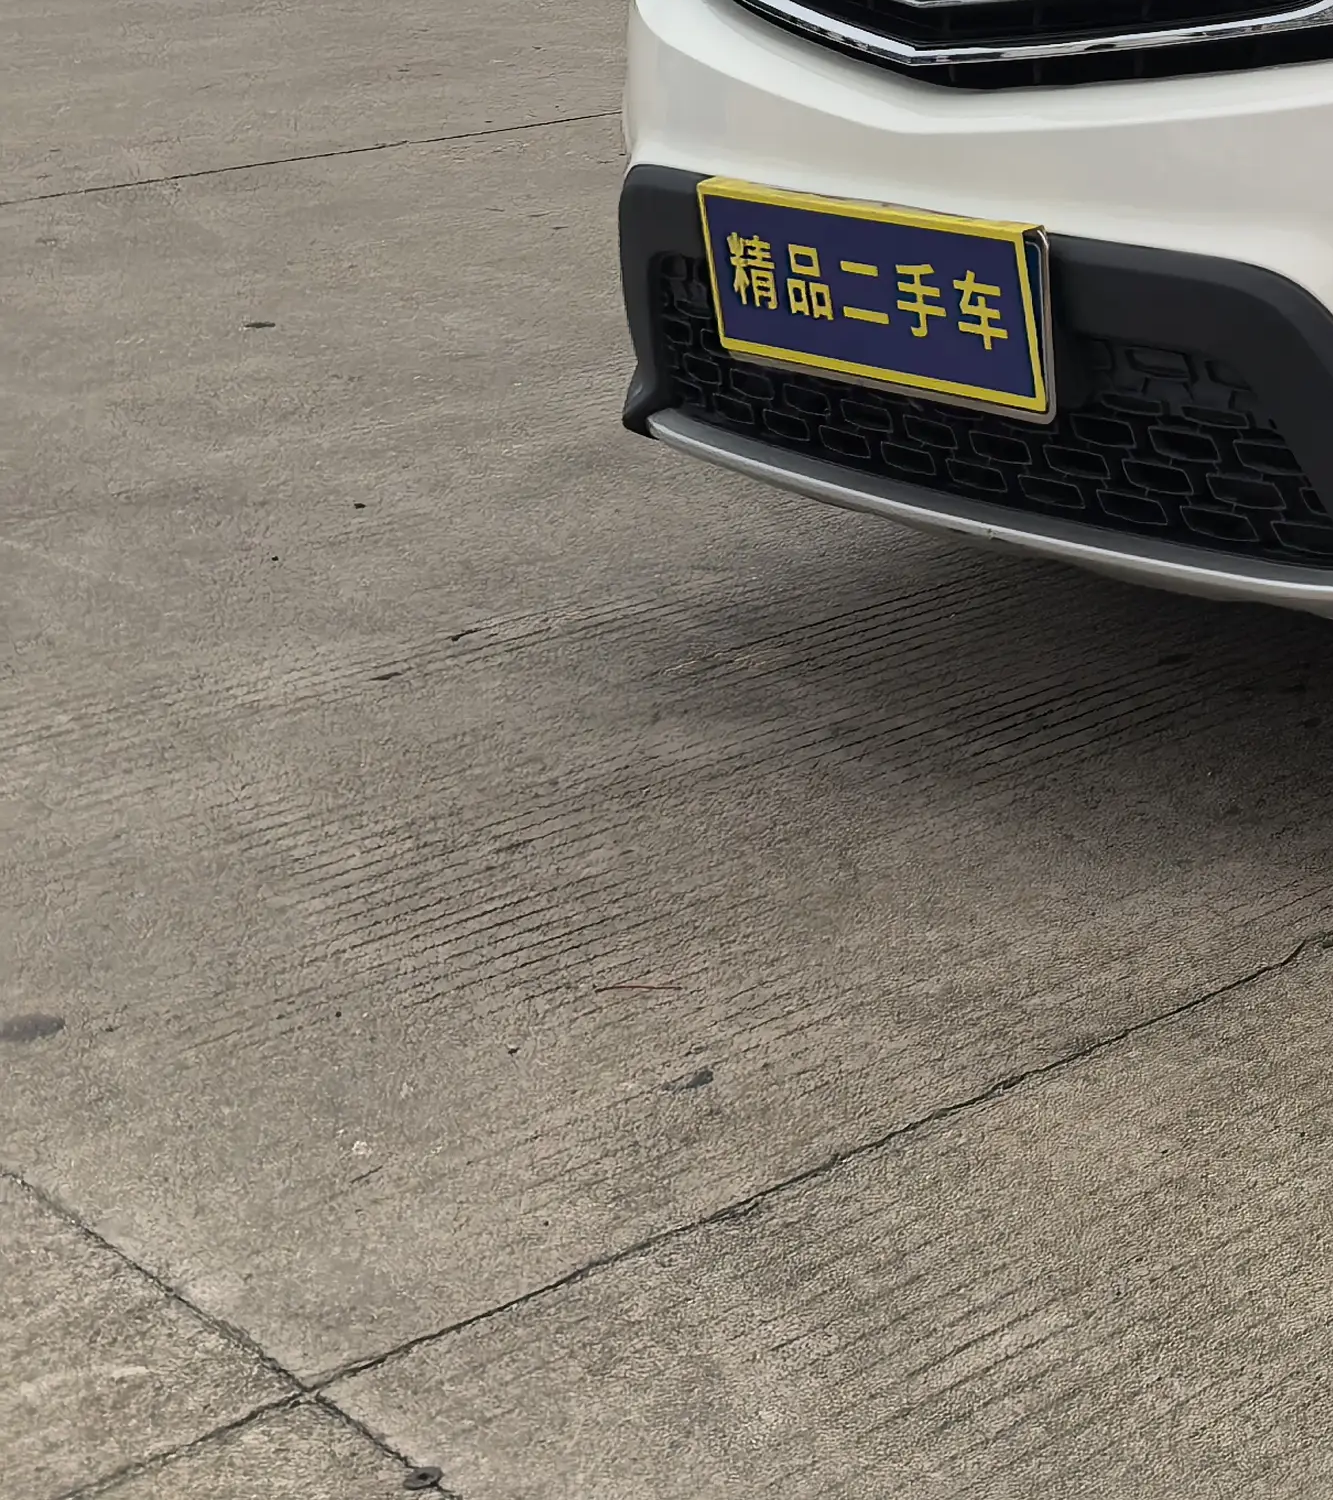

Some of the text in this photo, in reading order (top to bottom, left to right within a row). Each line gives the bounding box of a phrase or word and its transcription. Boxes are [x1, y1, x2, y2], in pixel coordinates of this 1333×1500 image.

[726, 231, 1009, 350] 精品二手车
